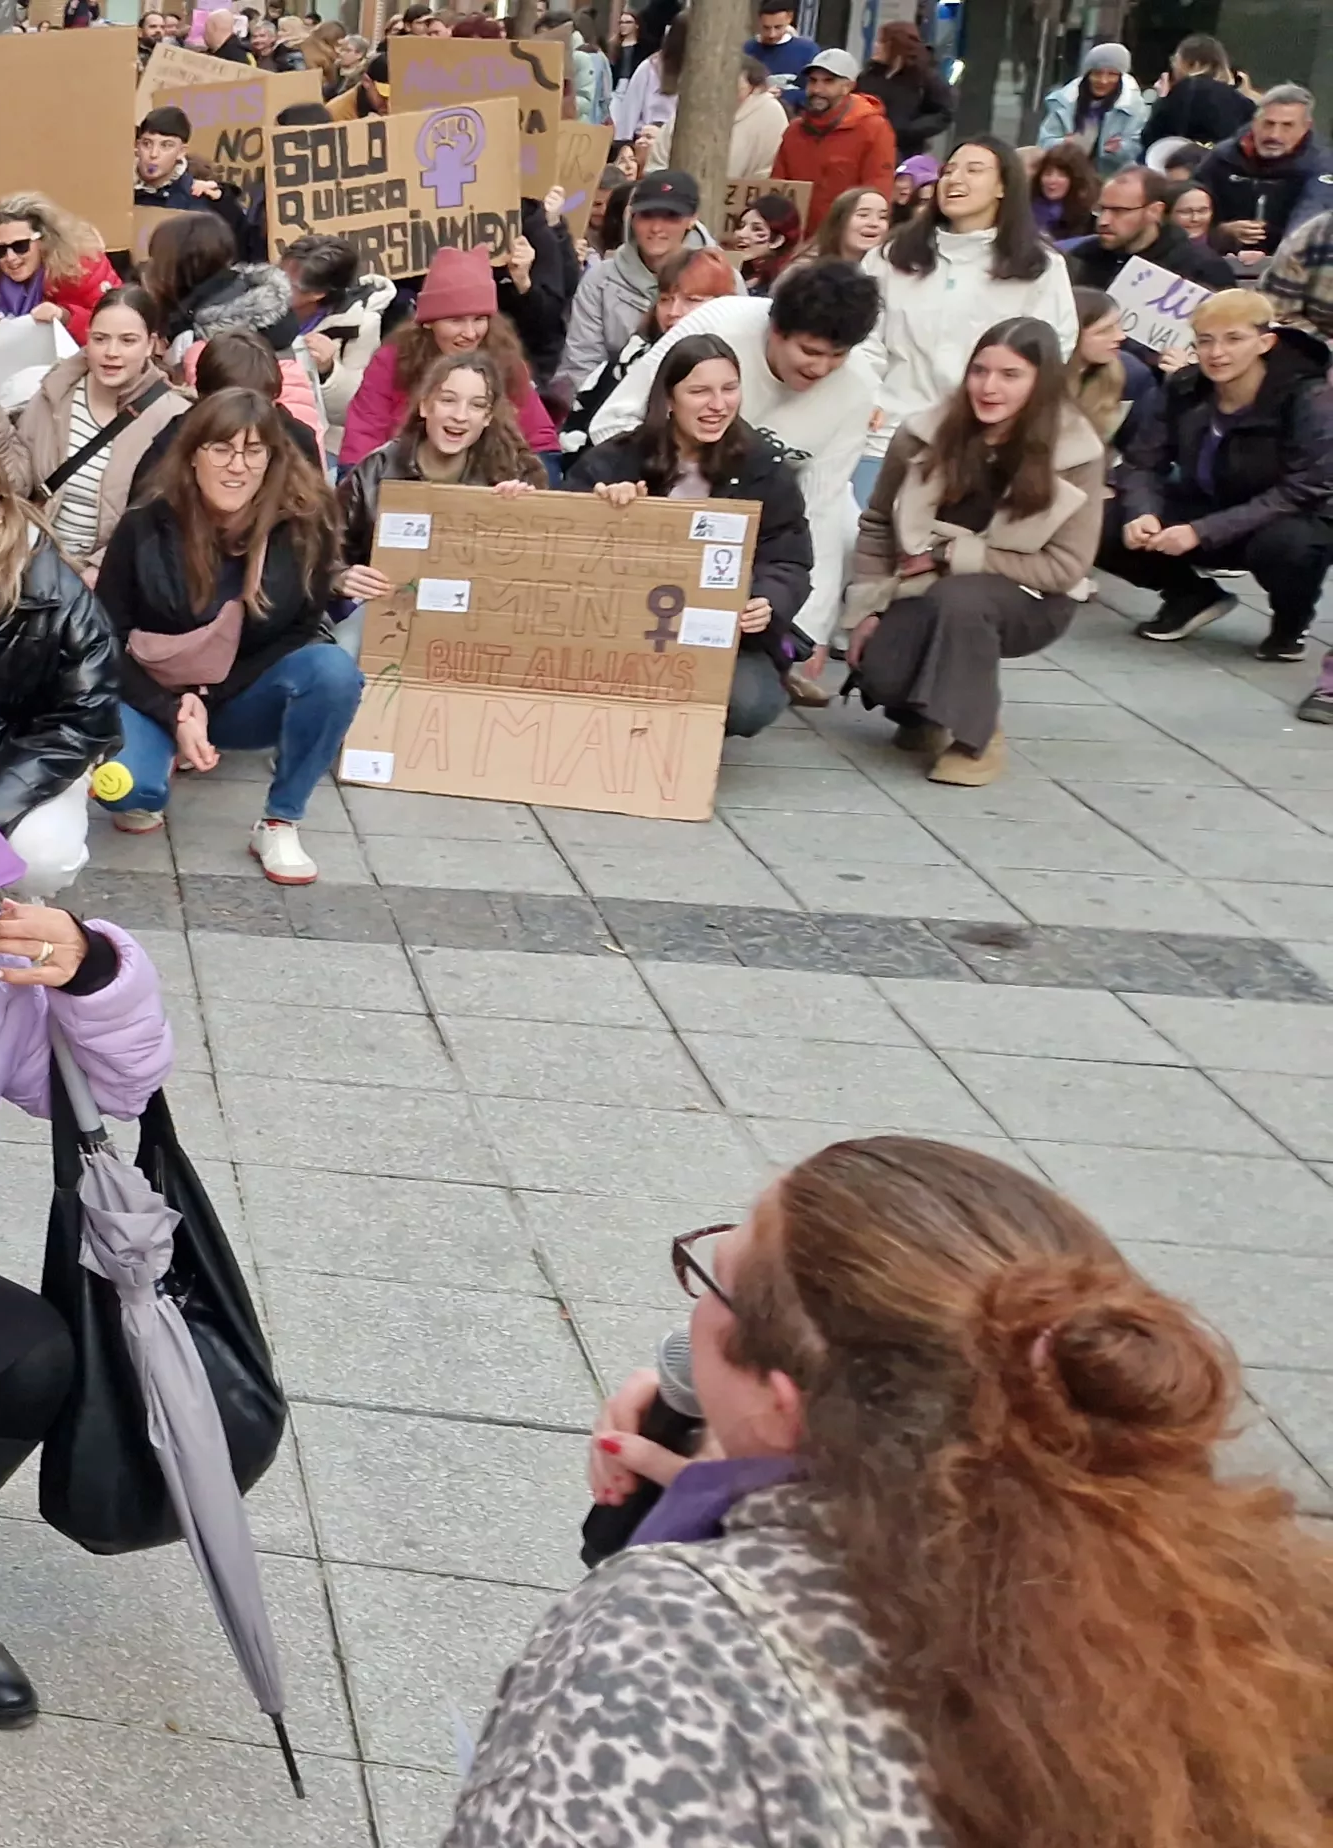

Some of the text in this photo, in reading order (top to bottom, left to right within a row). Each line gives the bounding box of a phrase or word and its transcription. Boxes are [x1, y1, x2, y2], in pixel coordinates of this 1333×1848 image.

[273, 120, 388, 187] SOLO
[428, 512, 688, 580] NOT ALL
[464, 574, 625, 639] MEN
[425, 638, 512, 685] BUT
[406, 696, 688, 800] A MAN
